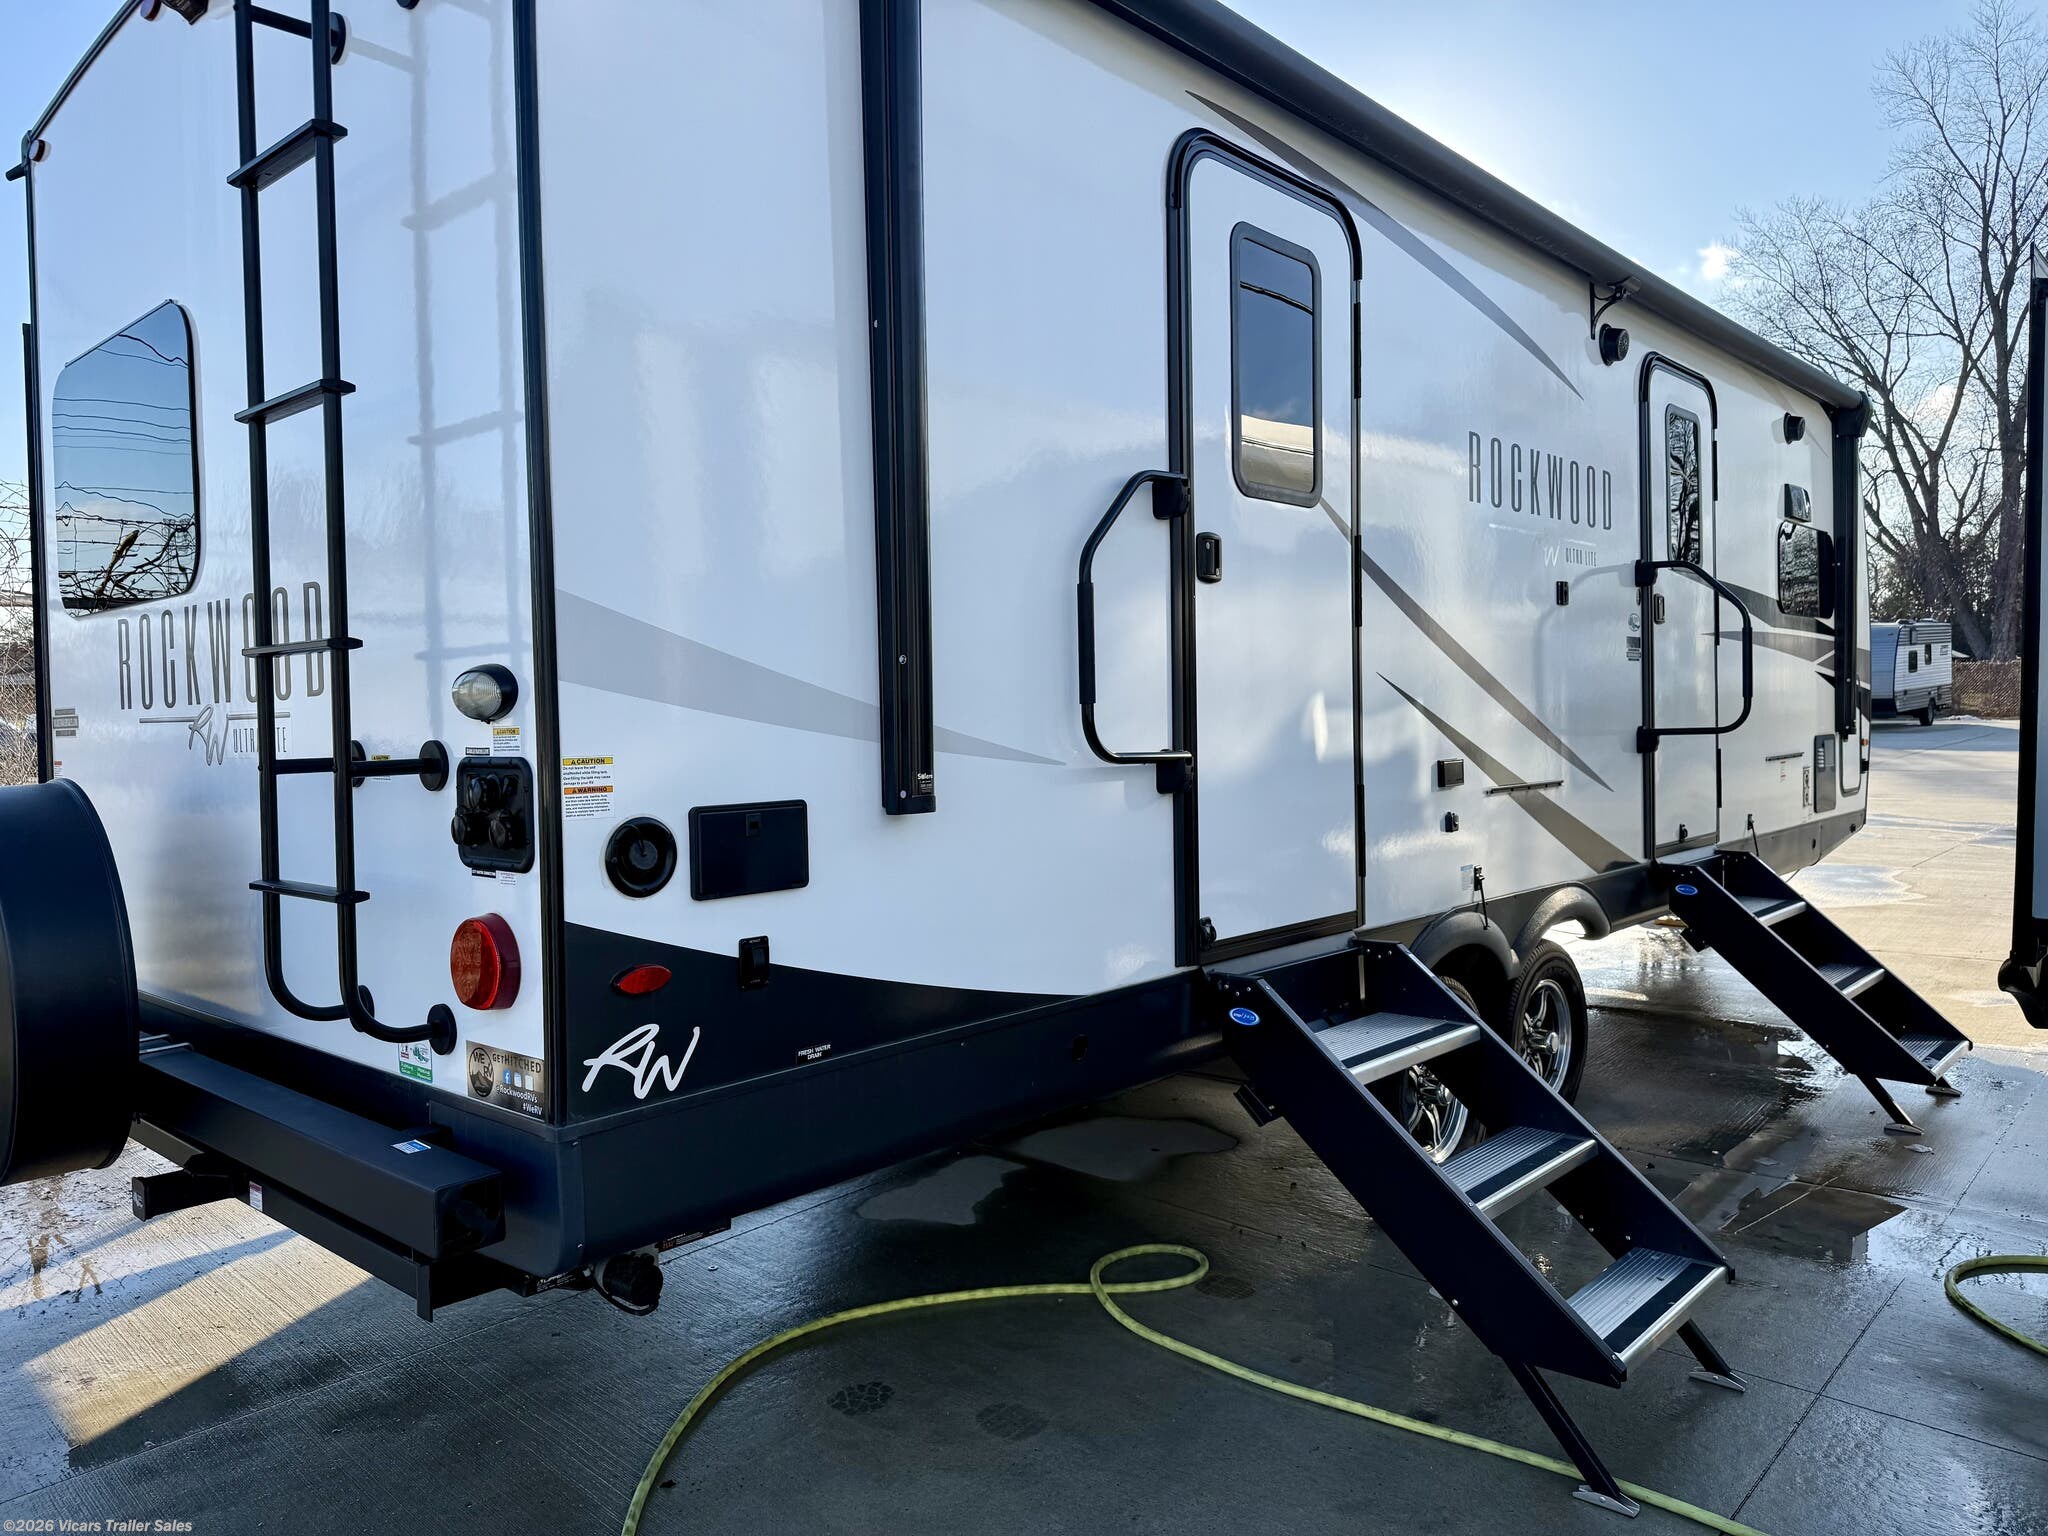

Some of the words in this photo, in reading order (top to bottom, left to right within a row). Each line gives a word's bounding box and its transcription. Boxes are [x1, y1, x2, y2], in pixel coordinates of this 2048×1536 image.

[1468, 430, 1612, 530] ROCKWOOD
[117, 581, 325, 710] ROCKWOOD
[232, 727, 260, 753] ULTR
[578, 786, 607, 794] WARNING
[815, 1044, 831, 1052] WATER
[473, 1051, 485, 1064] WE
[582, 1023, 700, 1100] RW
[807, 1052, 822, 1060] DRAIN
[483, 1064, 493, 1079] RV
